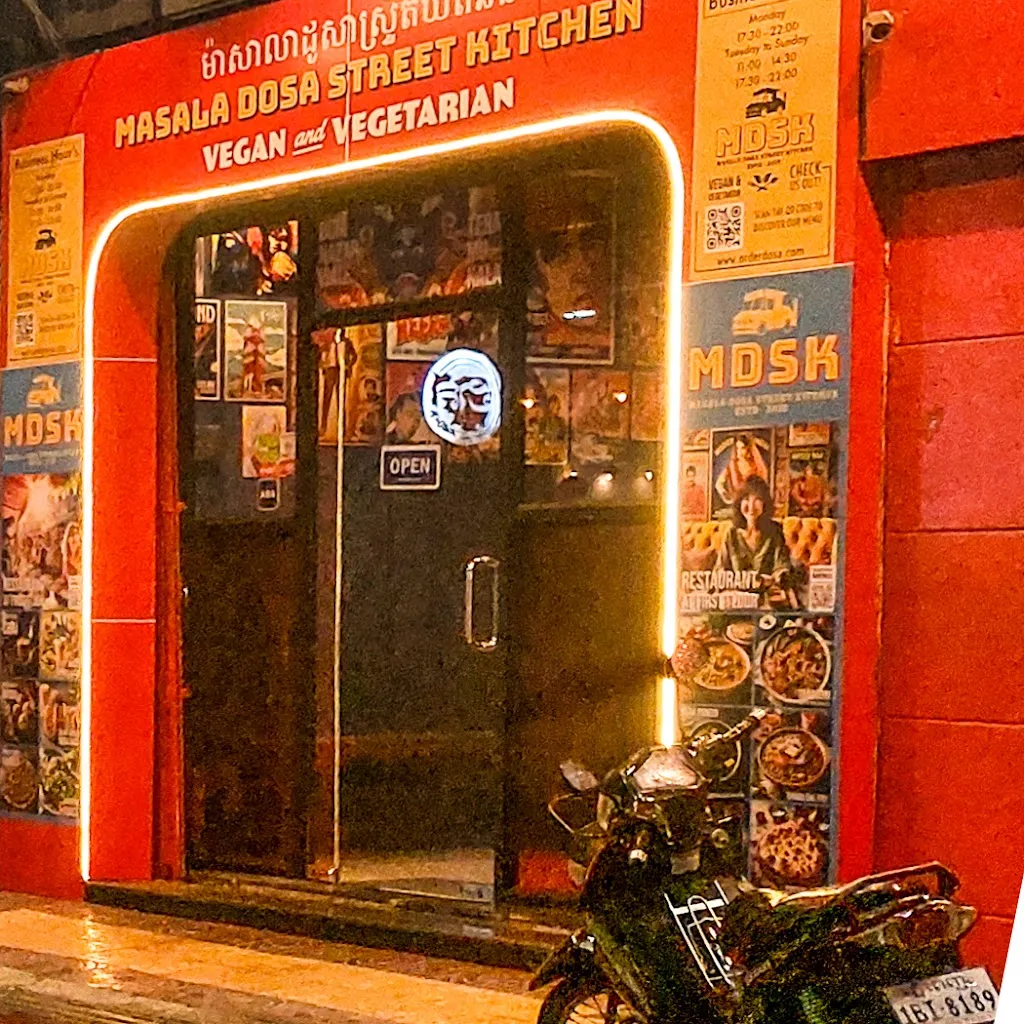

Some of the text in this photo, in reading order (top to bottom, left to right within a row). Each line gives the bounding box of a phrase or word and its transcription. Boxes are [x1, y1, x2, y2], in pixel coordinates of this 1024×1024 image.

[115, 92, 230, 149] MASALA
[237, 70, 320, 120] DOSA
[327, 36, 458, 100] STREET
[202, 76, 515, 172] VEGAN and VEGETARIAN
[715, 113, 816, 158] MDSK
[789, 161, 823, 179] CHECK
[687, 333, 840, 391] MDSK
[3, 408, 83, 447] MDSK
[389, 457, 431, 475] OPEN
[681, 570, 759, 591] RESTAURANT
